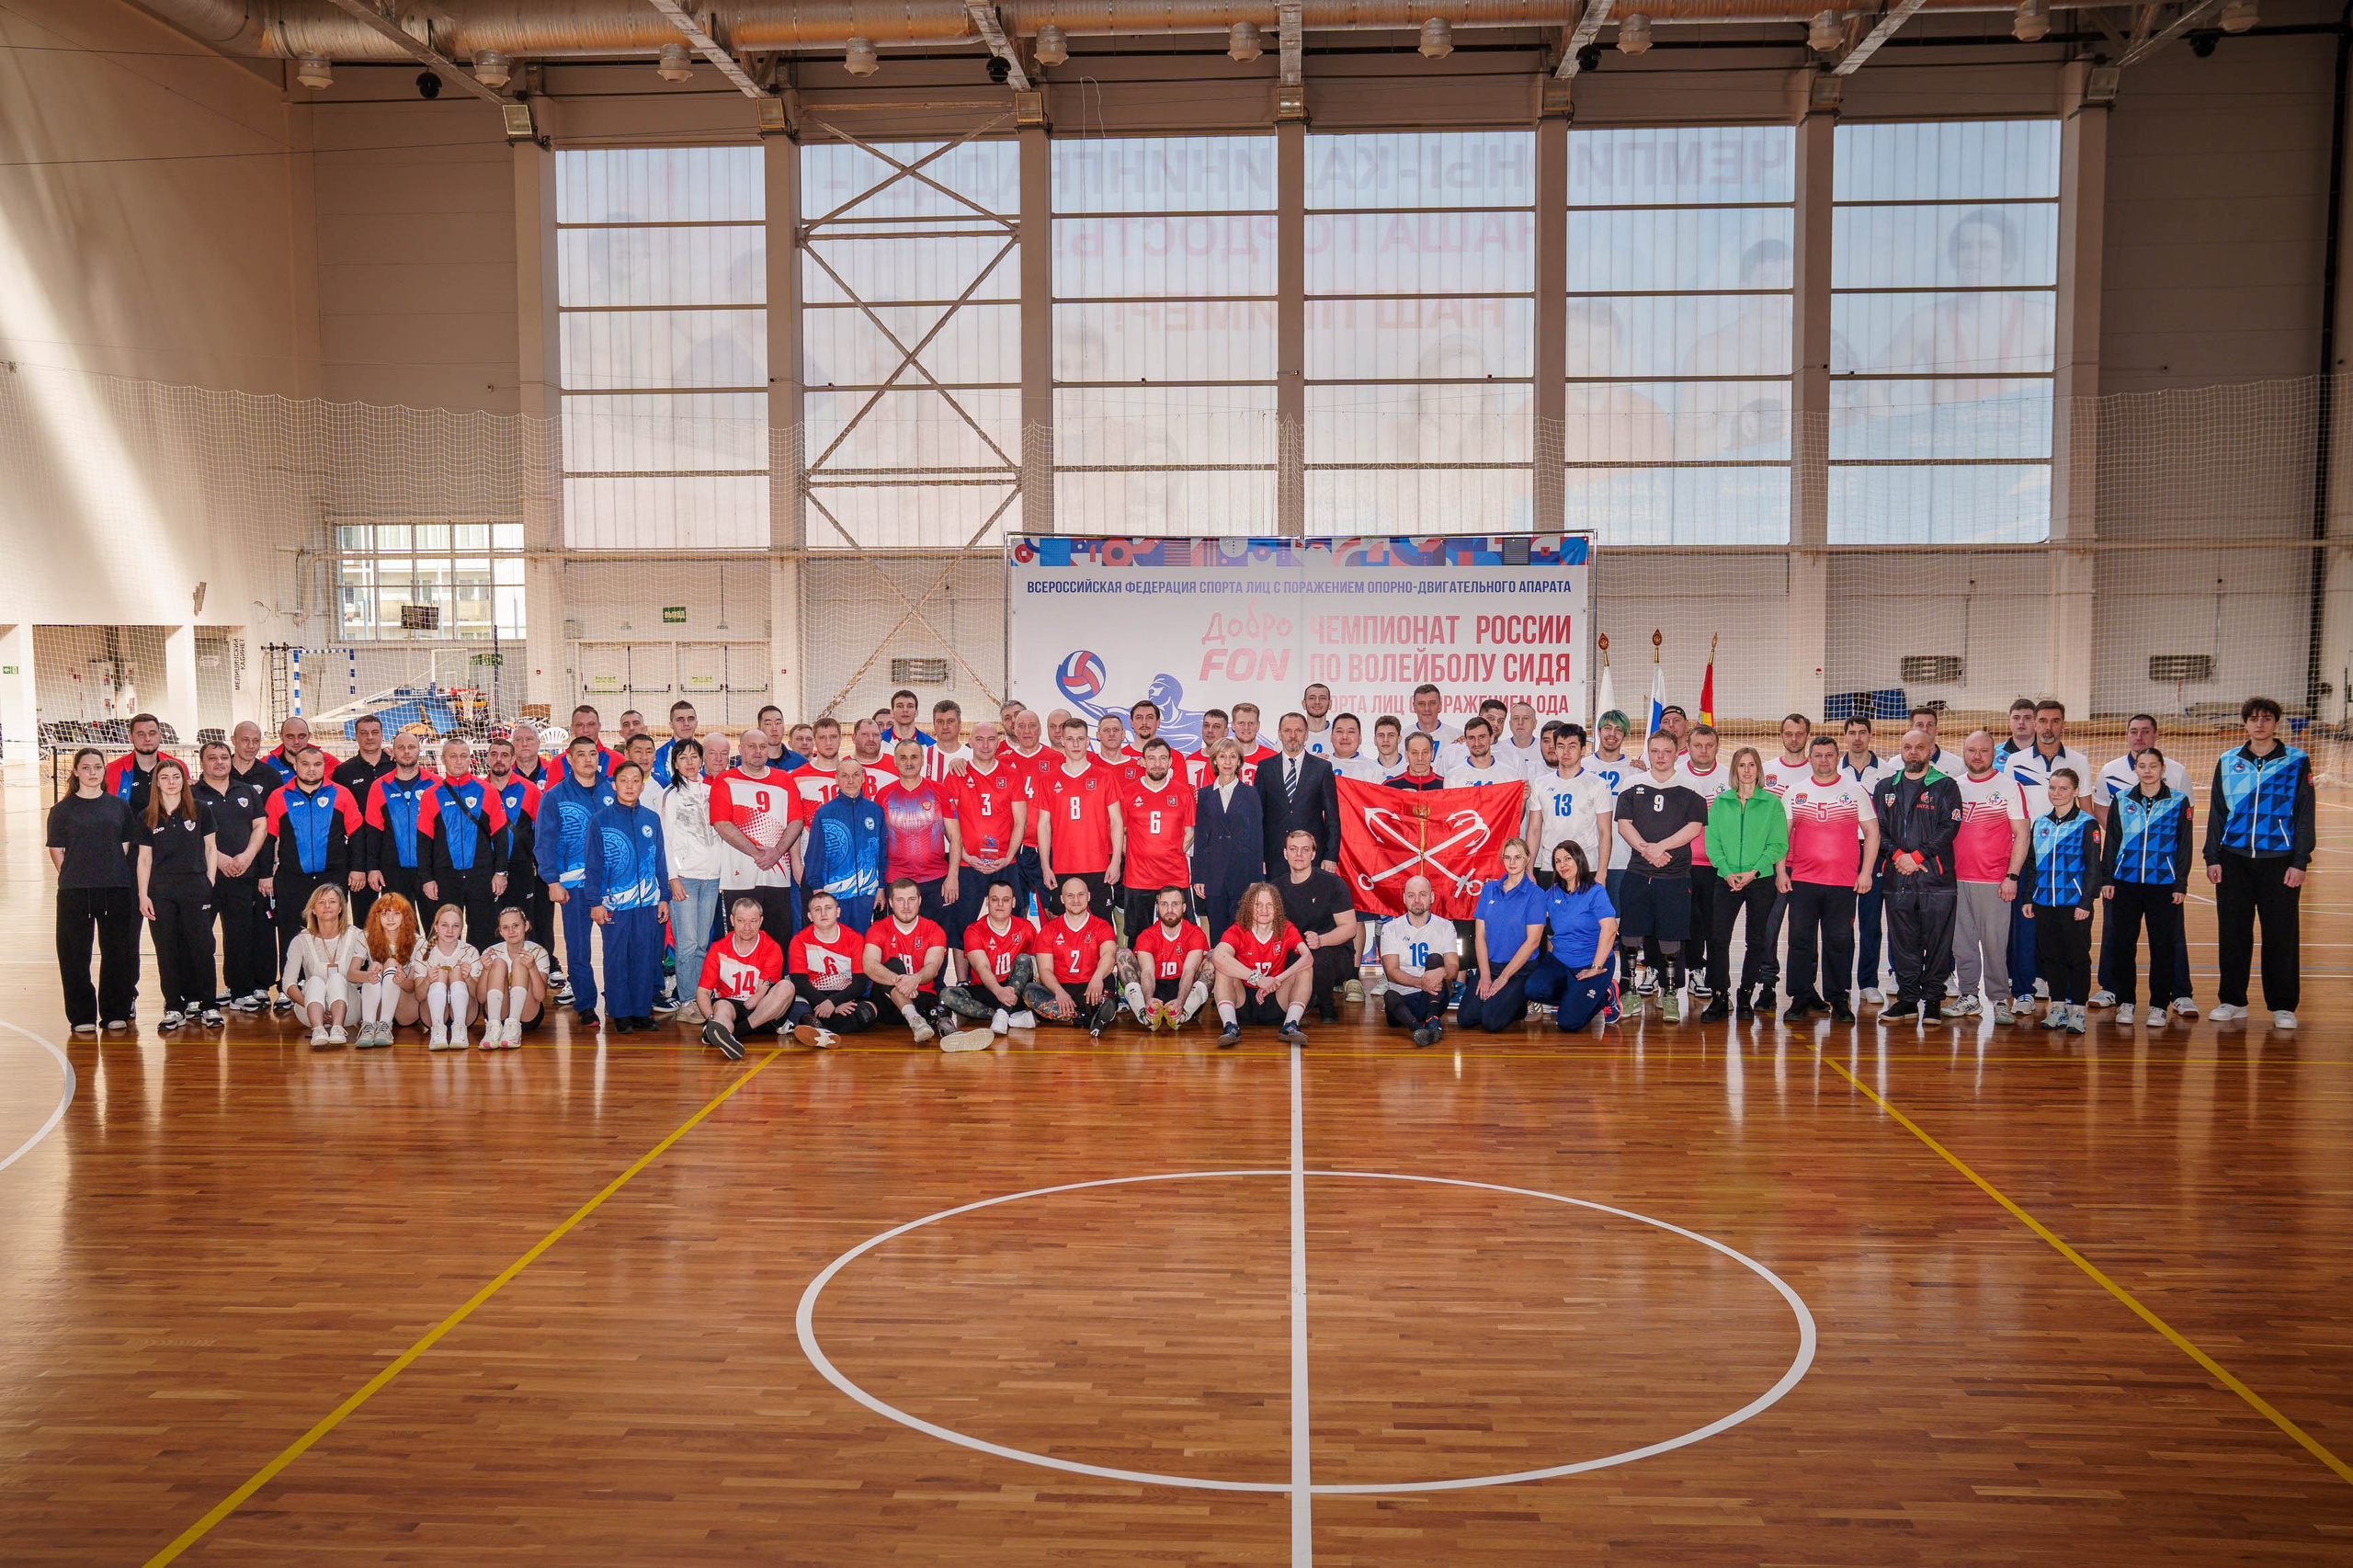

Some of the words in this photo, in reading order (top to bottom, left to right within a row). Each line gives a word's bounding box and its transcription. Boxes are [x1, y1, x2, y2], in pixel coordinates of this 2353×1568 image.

[1027, 578, 1122, 594] ВСЕРОССИЙСКАЯ
[1125, 580, 1197, 595] ФЕДЕРАЦИЯ
[1199, 580, 1242, 594] СПОРТА
[1245, 581, 1270, 596] ЛИЦ
[1274, 581, 1281, 594] С
[1283, 581, 1364, 594] ПОРАЖЕНИЕМ
[1368, 580, 1516, 595] ОПОРНО-ДВИГАТЕЛЬНОГО
[1518, 580, 1572, 594] АПАРАТА
[1201, 597, 1293, 645] Добро
[1309, 615, 1461, 645] ЧЕМПИОНАТ
[1476, 615, 1572, 644] РОССИИ
[1199, 648, 1291, 681] FON
[1310, 653, 1341, 683] ПО
[1348, 647, 1496, 684] ВОЛЕЙБОЛУ
[1503, 653, 1571, 686] СИДЯ
[1371, 695, 1404, 716] ЛИЦ
[1536, 694, 1569, 716] ОДА
[1024, 776, 1035, 799] 4
[756, 790, 770, 813] 9
[981, 793, 992, 816] 3
[1070, 796, 1081, 820] 8
[1553, 793, 1572, 817] 13
[1654, 794, 1665, 812] 9
[1816, 802, 1828, 822] 5
[1964, 801, 1977, 823] 7
[1150, 811, 1161, 835] 6
[824, 955, 838, 975] 6
[995, 952, 1011, 976] 10
[1070, 949, 1080, 973] 2
[1409, 942, 1429, 966] 16
[1161, 961, 1177, 978] 10
[733, 971, 756, 996] 14
